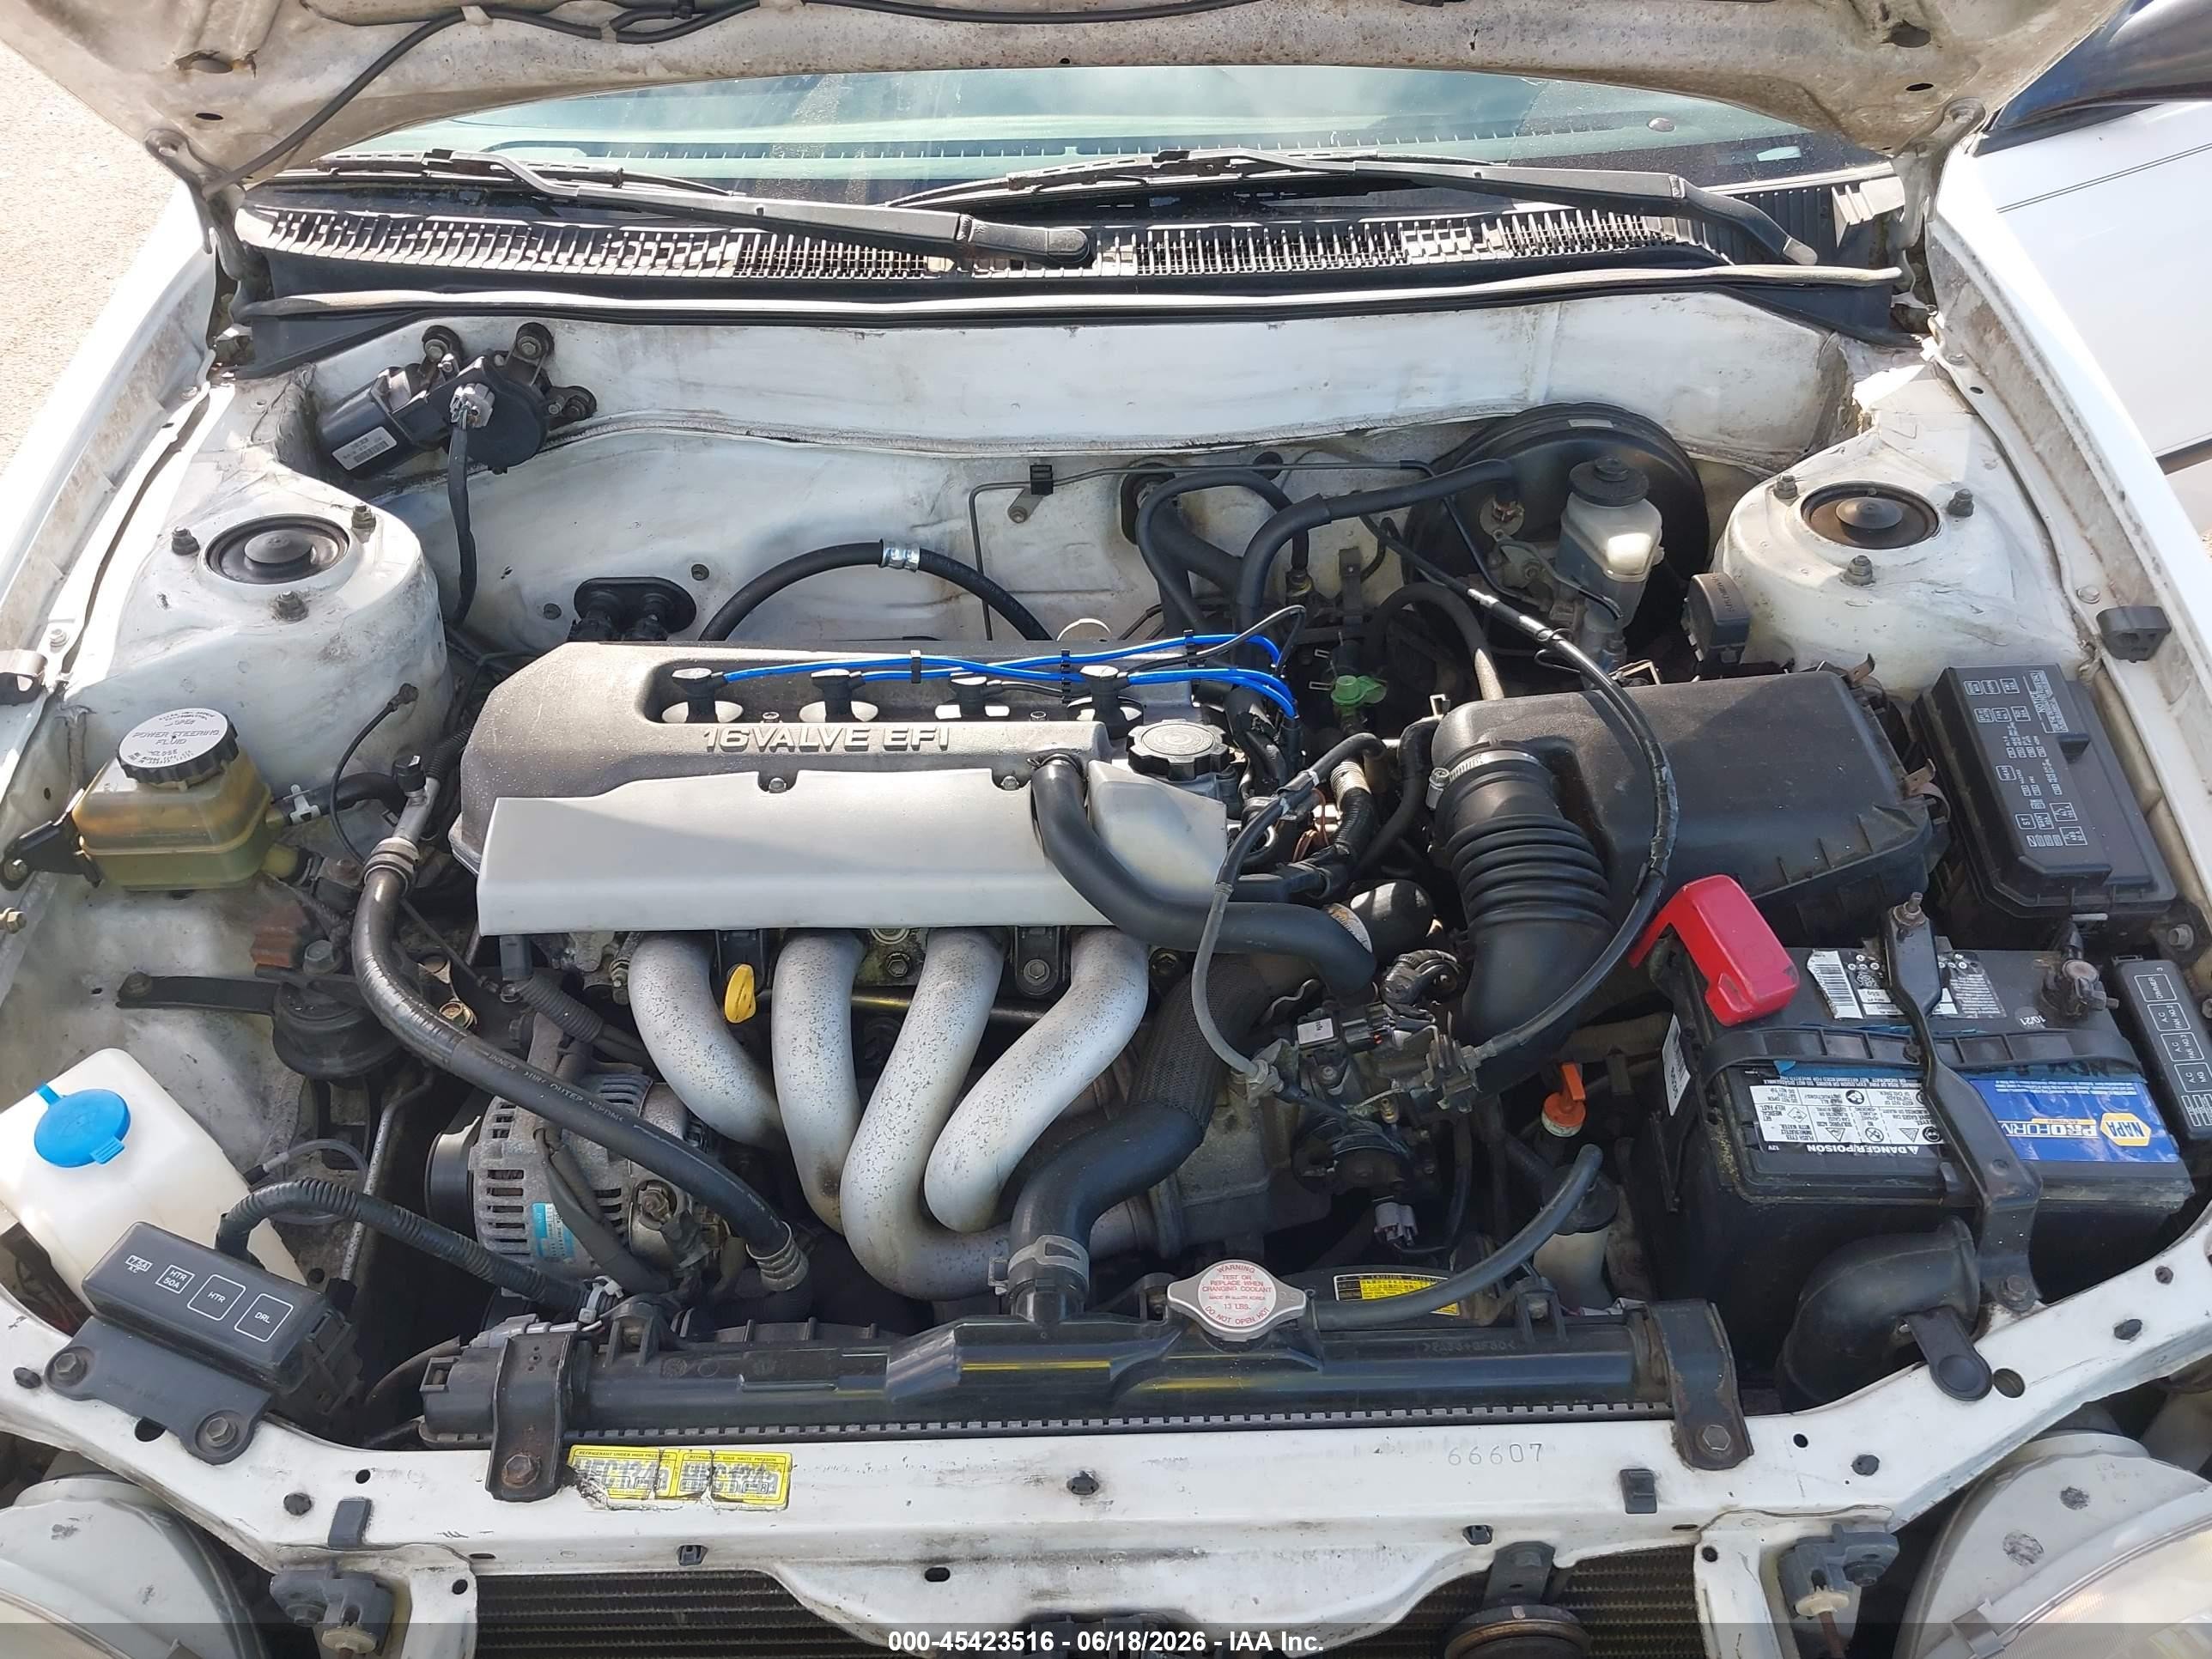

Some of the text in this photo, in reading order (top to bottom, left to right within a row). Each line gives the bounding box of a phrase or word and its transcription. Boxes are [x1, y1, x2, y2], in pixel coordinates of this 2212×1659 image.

[702, 726, 950, 752] 16VALVE EFI
[2147, 976, 2163, 998] DIMMER
[2020, 1014, 2046, 1026] 10/21
[2106, 1121, 2145, 1137] NAPA
[1807, 1144, 1906, 1153] DANGER/POISON
[170, 1269, 187, 1280] HTR
[1217, 1264, 1255, 1273] WARNING
[163, 1279, 180, 1289] 50A
[207, 1291, 226, 1304] HTR
[254, 1311, 271, 1324] DRL
[1205, 1305, 1215, 1315] DO
[1217, 1314, 1231, 1322] NOT
[1257, 1307, 1271, 1320] HOT
[1448, 1443, 1542, 1466] 66607
